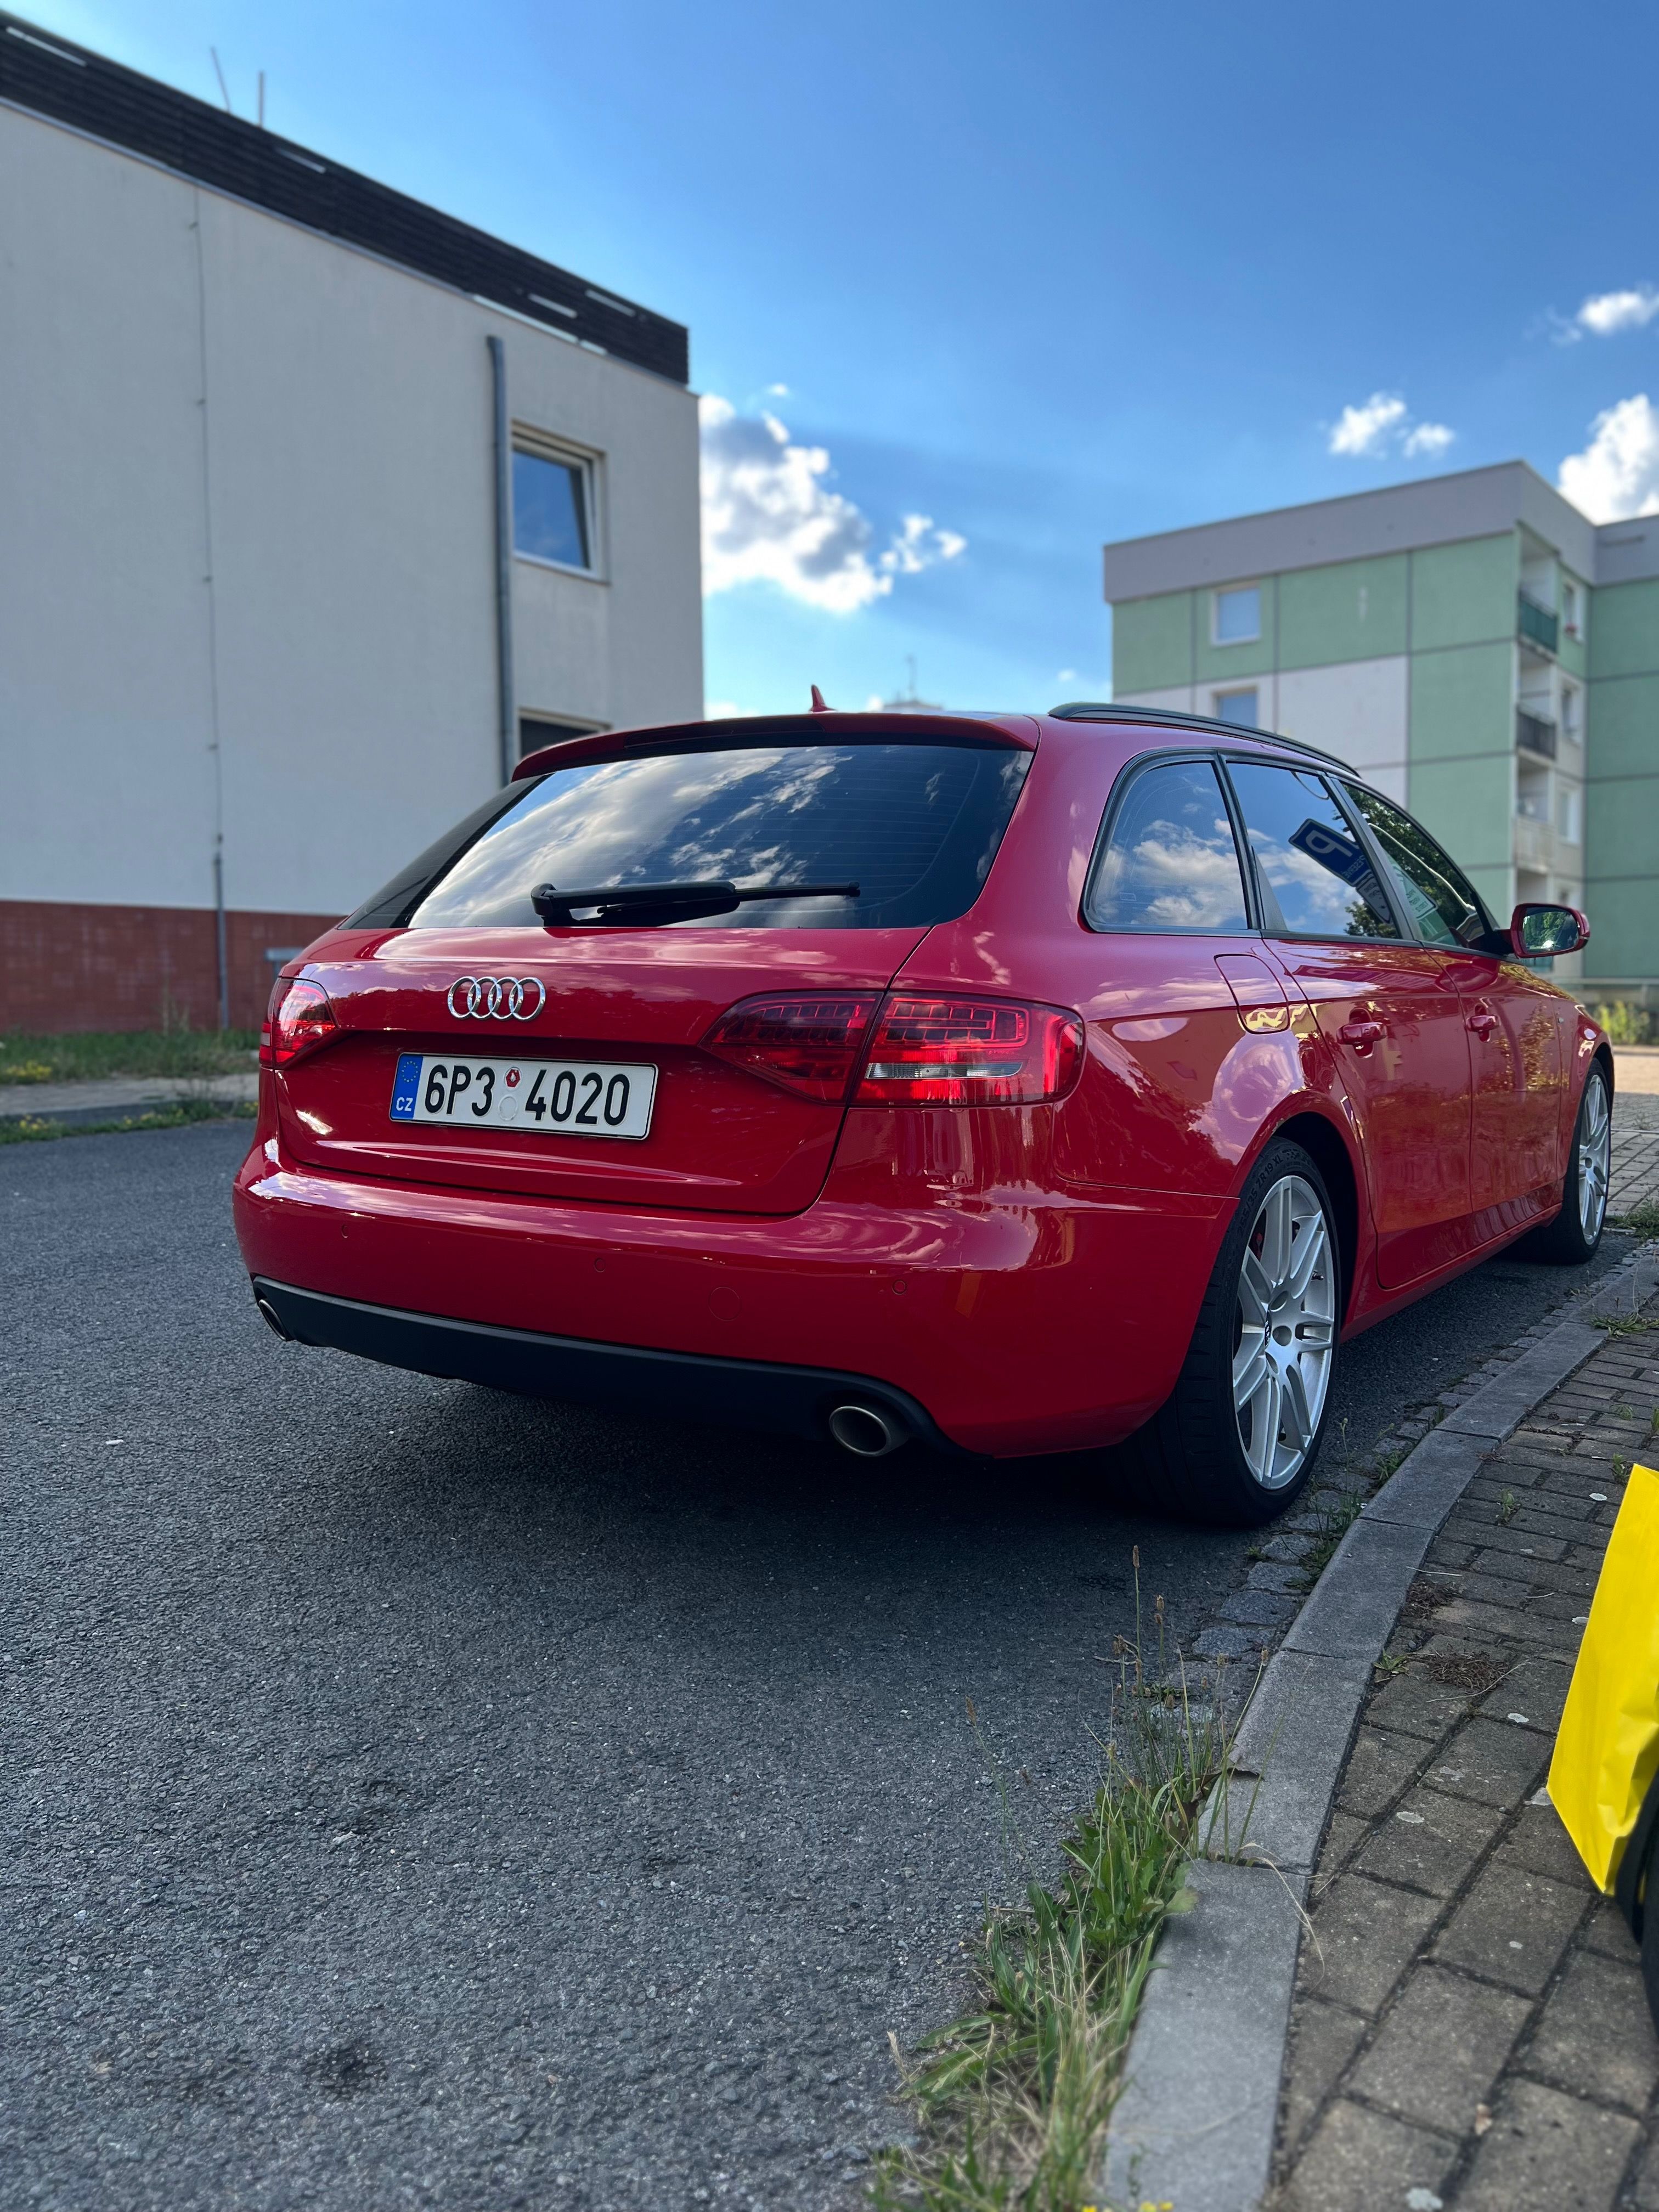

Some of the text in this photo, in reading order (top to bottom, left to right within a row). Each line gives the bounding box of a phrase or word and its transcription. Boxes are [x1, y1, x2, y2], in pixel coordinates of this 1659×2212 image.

[425, 1064, 630, 1126] 6P3 4020
[396, 1097, 413, 1111] CZ
[1272, 1155, 1283, 1167] XL
